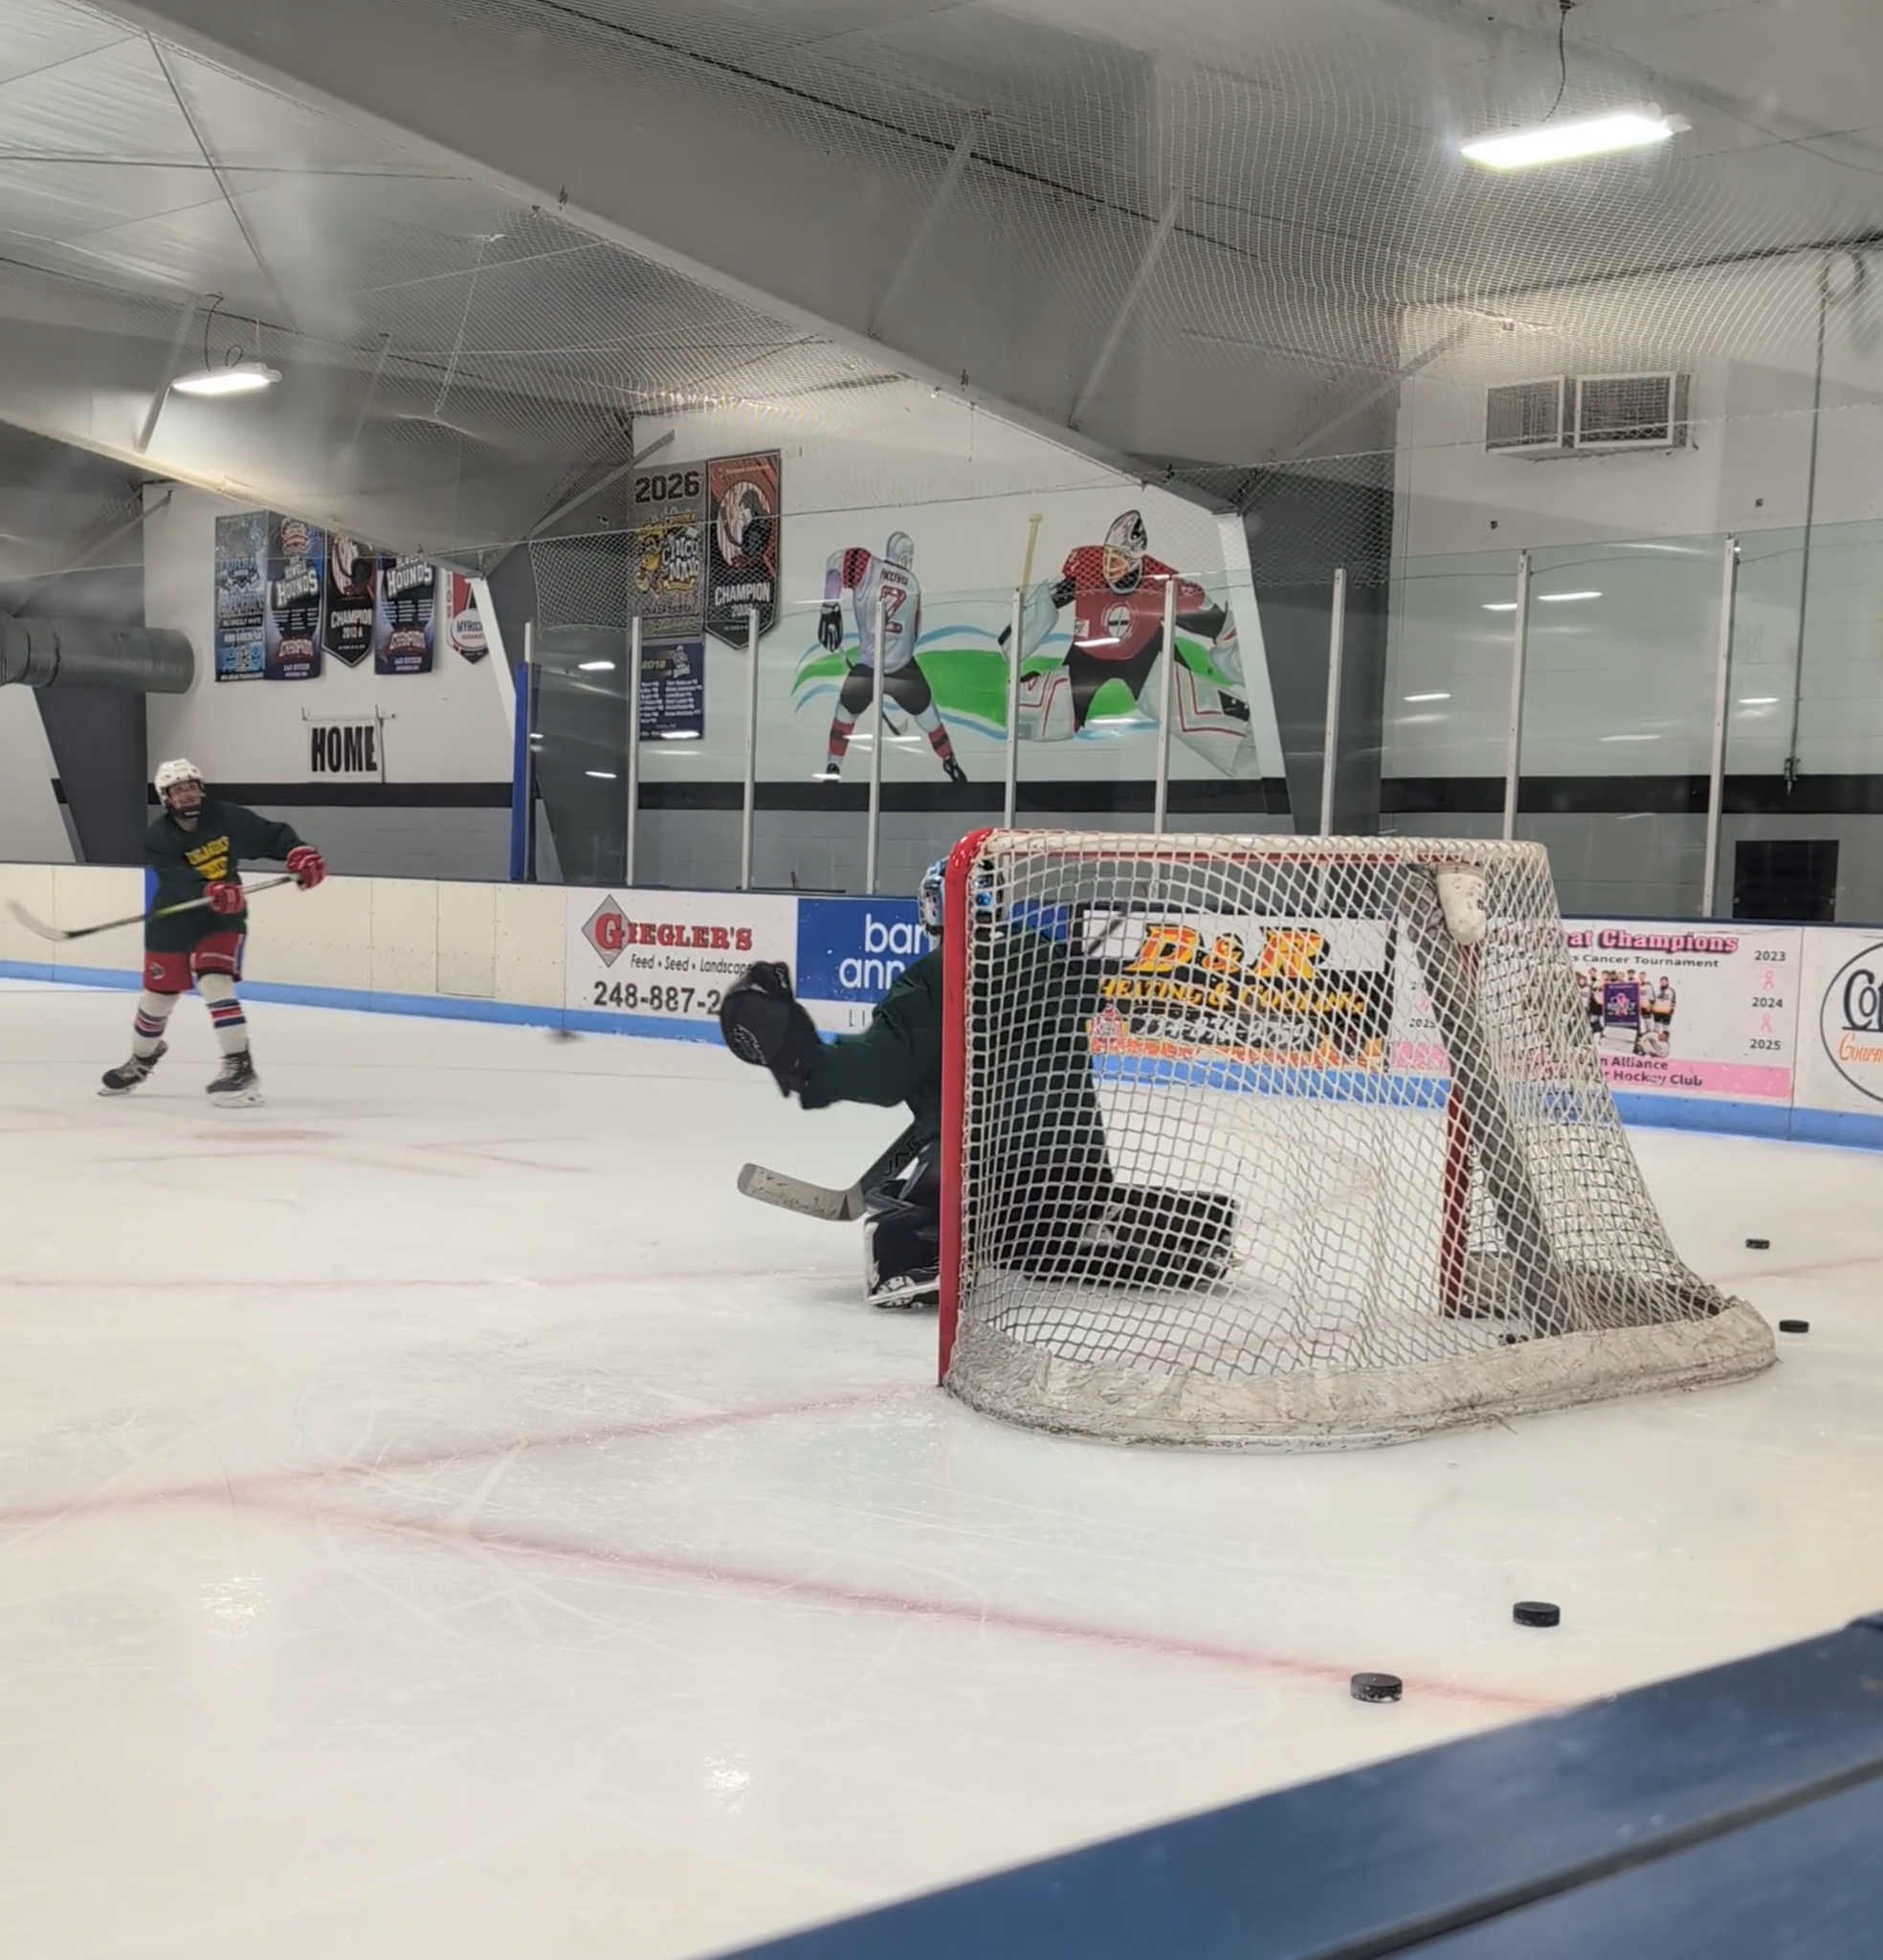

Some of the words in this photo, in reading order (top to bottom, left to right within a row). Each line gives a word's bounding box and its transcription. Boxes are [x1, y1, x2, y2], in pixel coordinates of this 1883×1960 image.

[634, 470, 701, 504] 2026
[277, 568, 319, 608] HOUNDS
[387, 561, 432, 597] HOUNDS
[715, 582, 771, 607] CHAMPION
[330, 608, 373, 629] CHAMPION
[311, 725, 378, 772] HOME
[594, 913, 753, 952] GIEGLER'S
[1599, 928, 1739, 954] Champions
[630, 953, 654, 969] Feed
[664, 955, 690, 971] Seed
[1123, 924, 1205, 973] D
[1201, 932, 1245, 973] &
[1247, 925, 1331, 978] R
[1583, 953, 1629, 965] Cancer
[1634, 956, 1720, 969] Tournament
[1754, 949, 1786, 963] 2023
[593, 980, 721, 1015] 248-887-2
[1751, 996, 1783, 1009] 2024
[1749, 1038, 1782, 1051] 2025
[1611, 1056, 1669, 1071] Alliance
[1613, 1070, 1667, 1086] Hockey
[1670, 1074, 1703, 1087] Club
